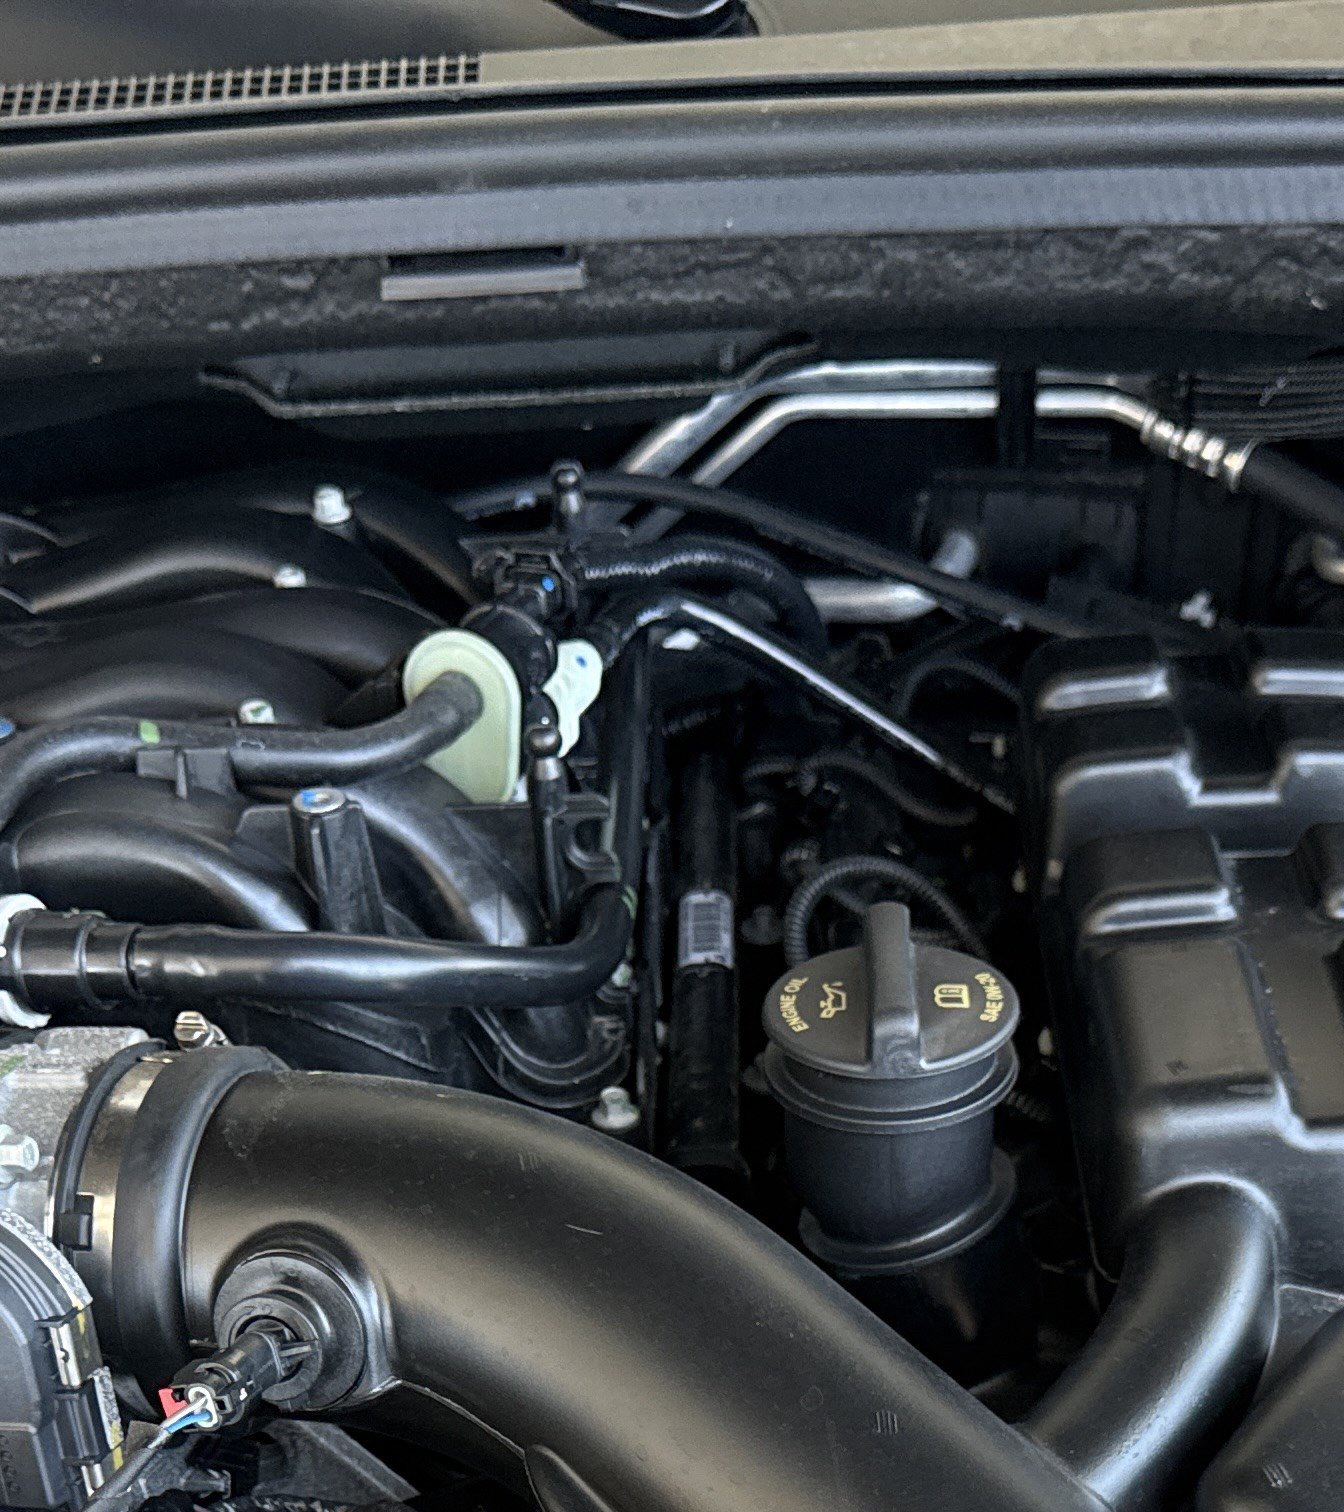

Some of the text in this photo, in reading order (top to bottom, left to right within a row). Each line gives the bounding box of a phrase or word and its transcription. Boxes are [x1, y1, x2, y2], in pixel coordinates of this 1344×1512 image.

[780, 977, 809, 1032] ENGINE OIL
[975, 973, 1004, 1022] SAE 0W-20
